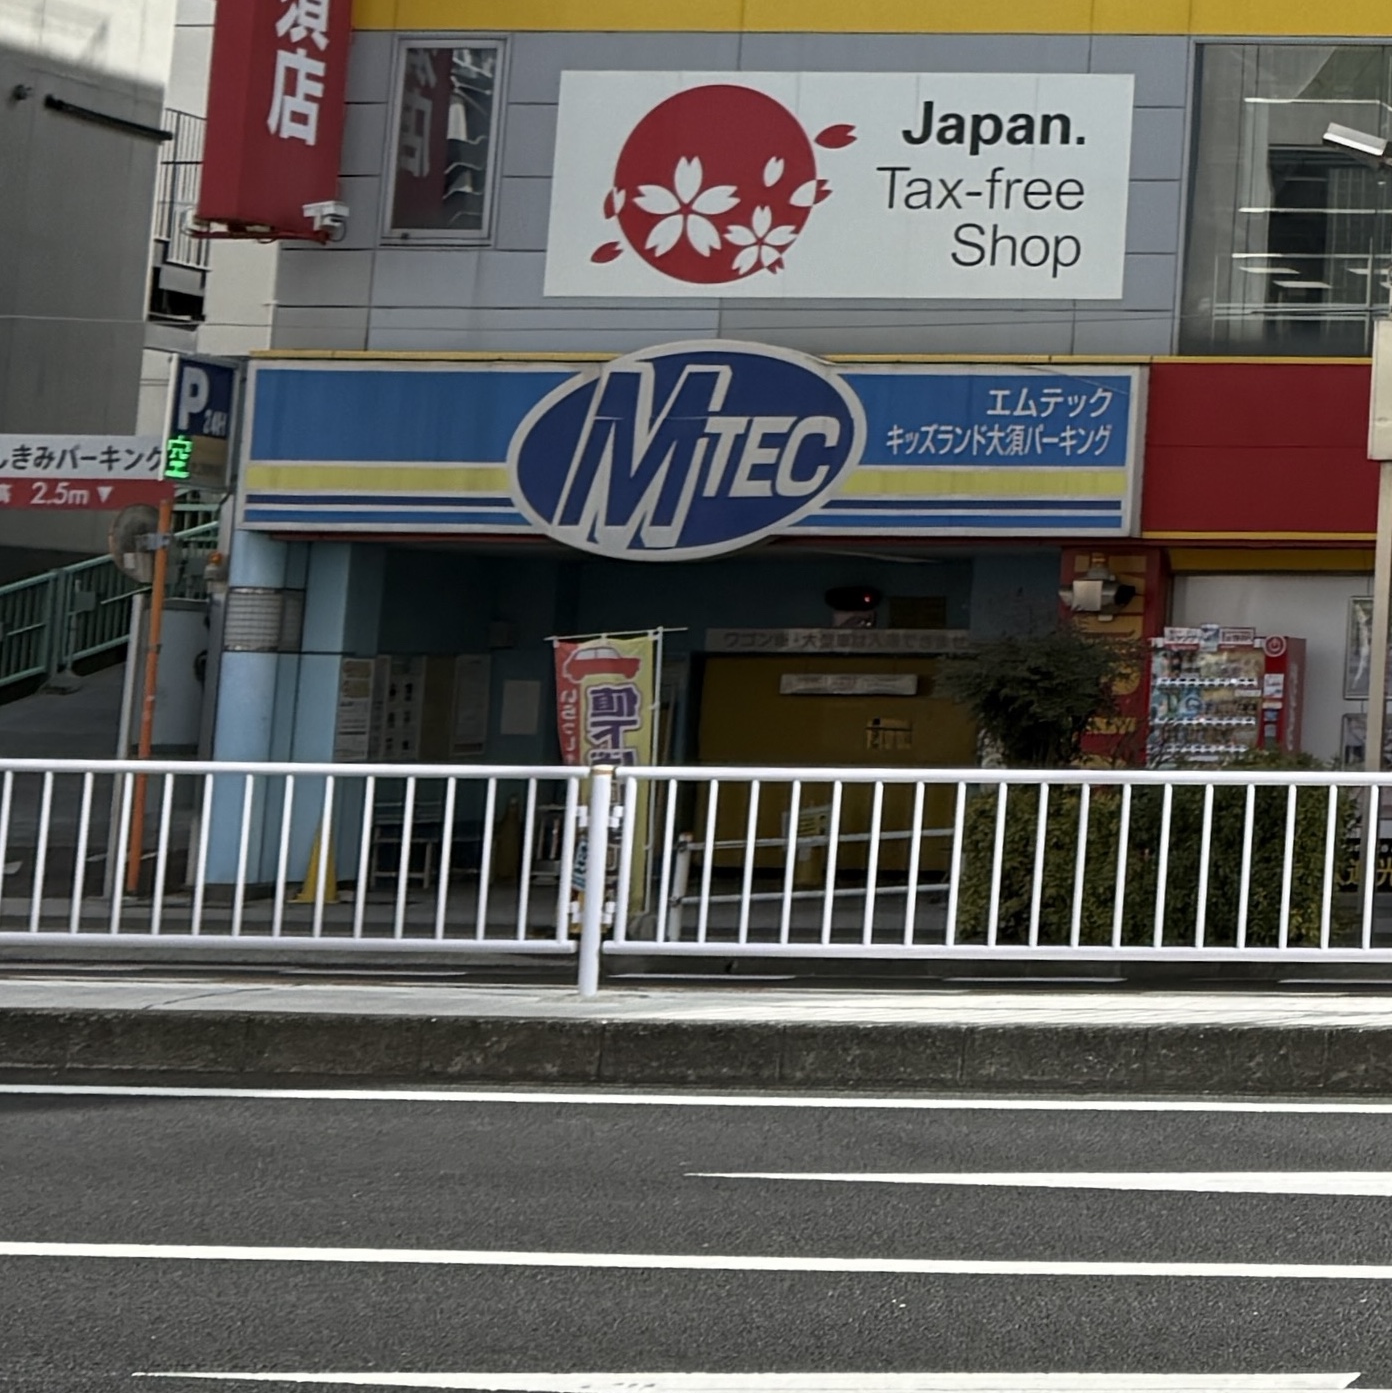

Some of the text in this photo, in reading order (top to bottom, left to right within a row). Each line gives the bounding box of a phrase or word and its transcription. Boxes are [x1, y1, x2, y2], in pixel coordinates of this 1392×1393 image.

[903, 101, 1086, 155] Japan.
[876, 168, 1084, 210] Tax-free
[951, 224, 1081, 278] Shop
[178, 366, 209, 430] P
[986, 390, 1112, 417] エムテック
[165, 435, 193, 478] 空
[886, 425, 1112, 456] キッズランド大須パーキング
[31, 483, 89, 505] 2.5m
